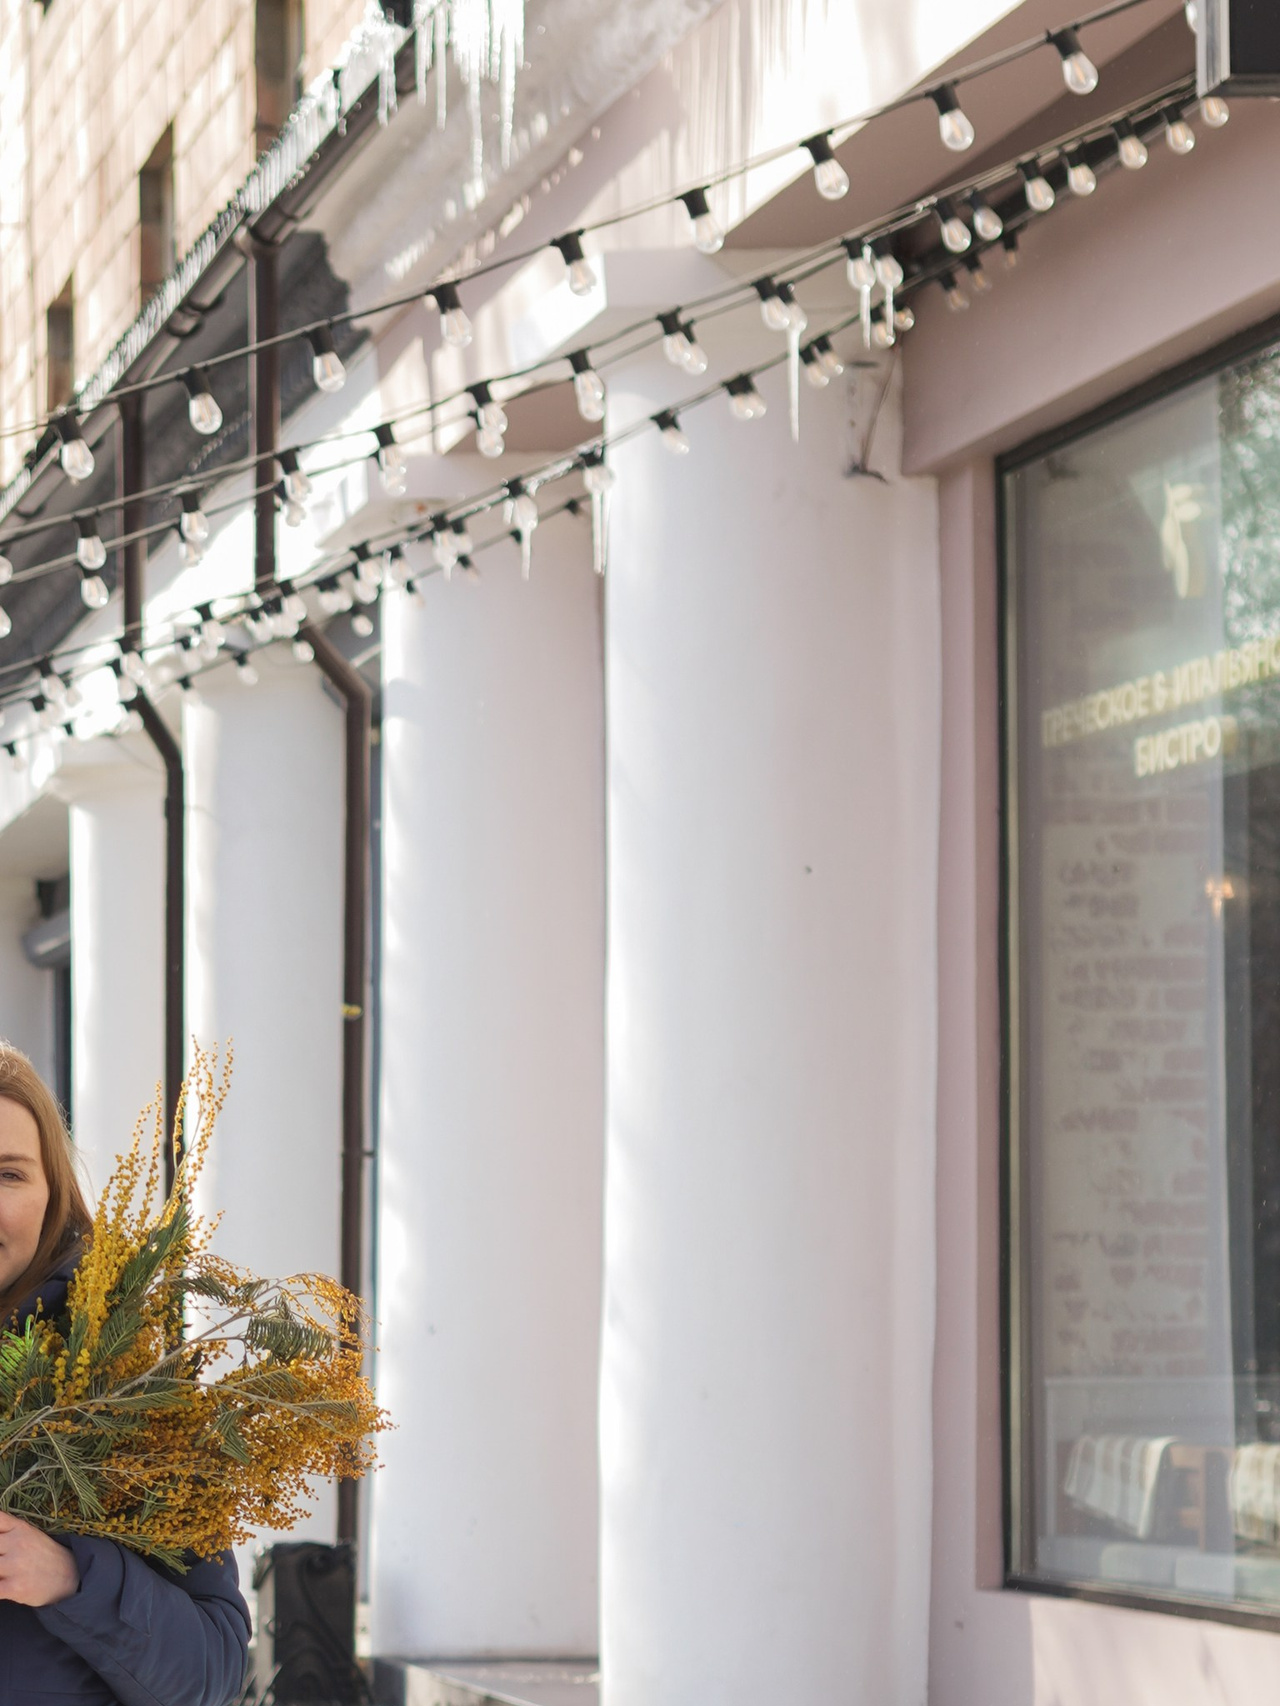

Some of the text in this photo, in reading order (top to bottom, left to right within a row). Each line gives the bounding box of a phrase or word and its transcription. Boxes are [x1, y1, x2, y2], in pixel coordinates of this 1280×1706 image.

[1042, 675, 1150, 748] ГРЕЧЕСКОЕ
[1152, 669, 1168, 712] &
[1135, 715, 1221, 778] БИСТРО
